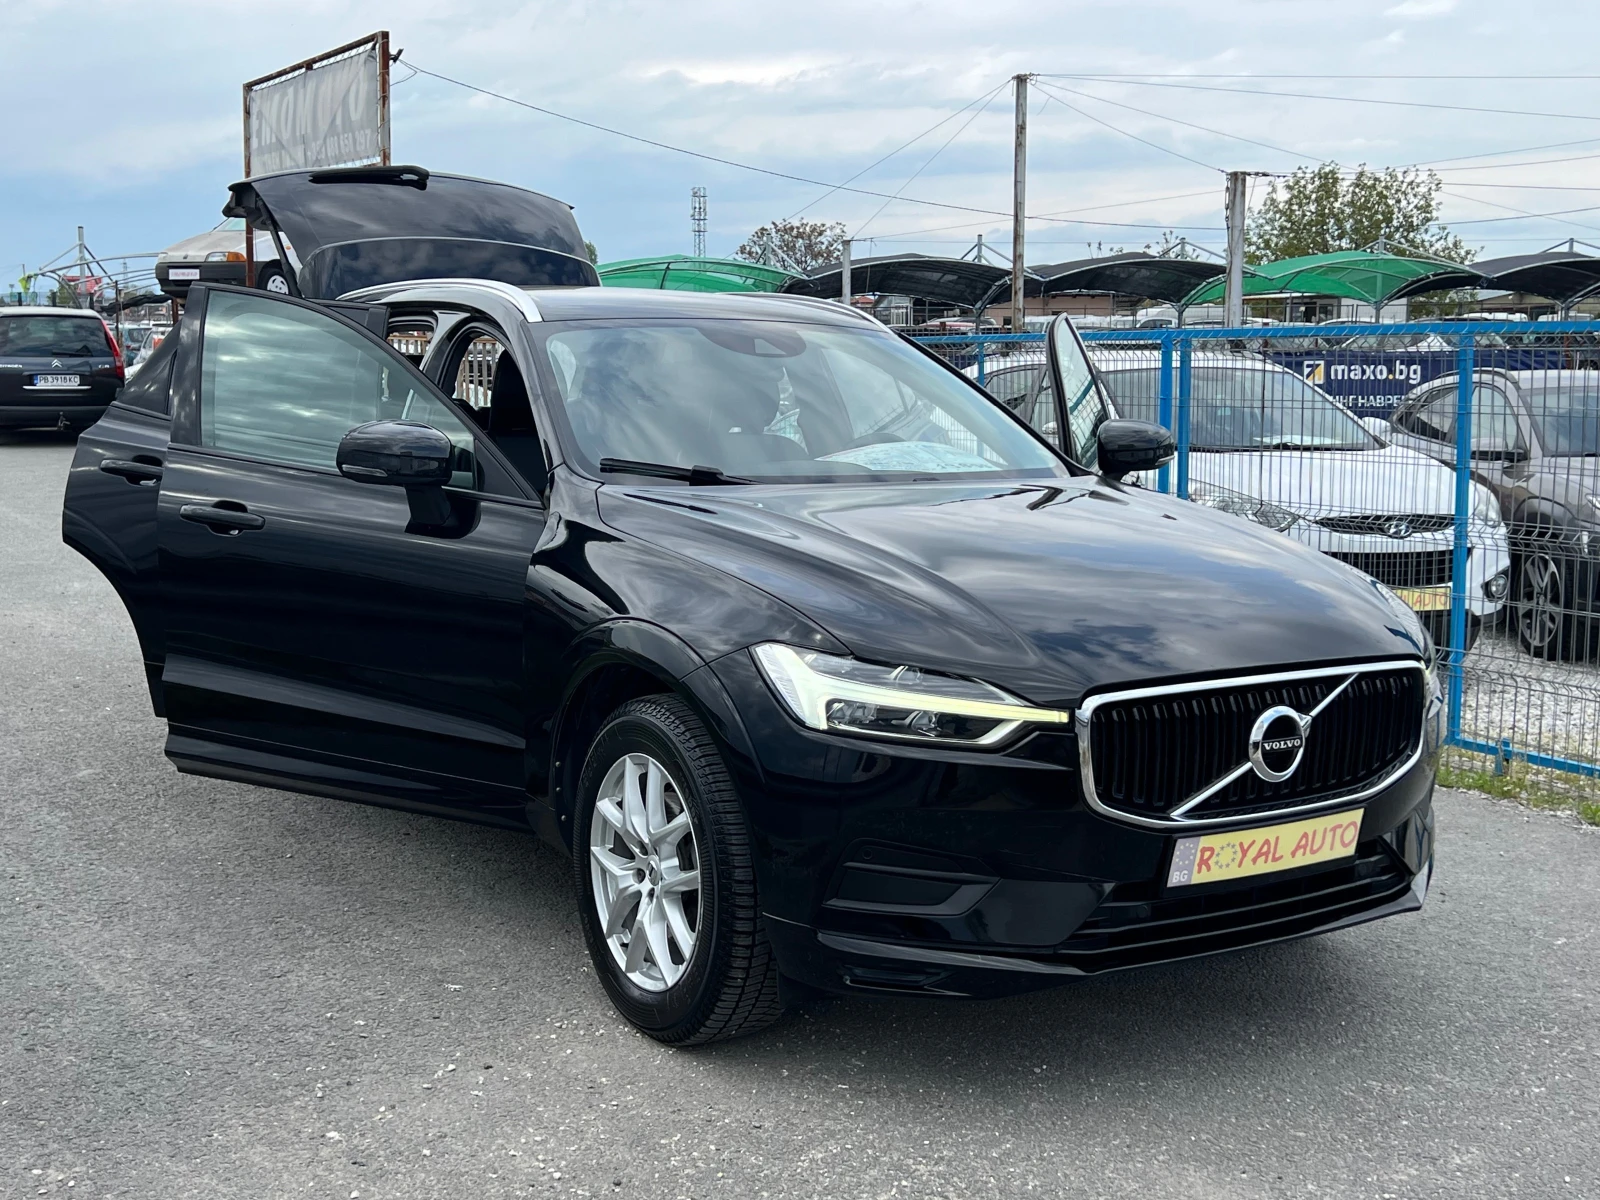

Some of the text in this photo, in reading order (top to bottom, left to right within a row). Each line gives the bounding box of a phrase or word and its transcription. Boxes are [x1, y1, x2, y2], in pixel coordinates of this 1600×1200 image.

[1330, 360, 1421, 384] maxo.bg
[1358, 395, 1405, 406] НАВРЕ
[1263, 739, 1301, 750] VOLVO
[1197, 821, 1359, 874] ROYAL AUTO
[1172, 870, 1188, 883] BG
